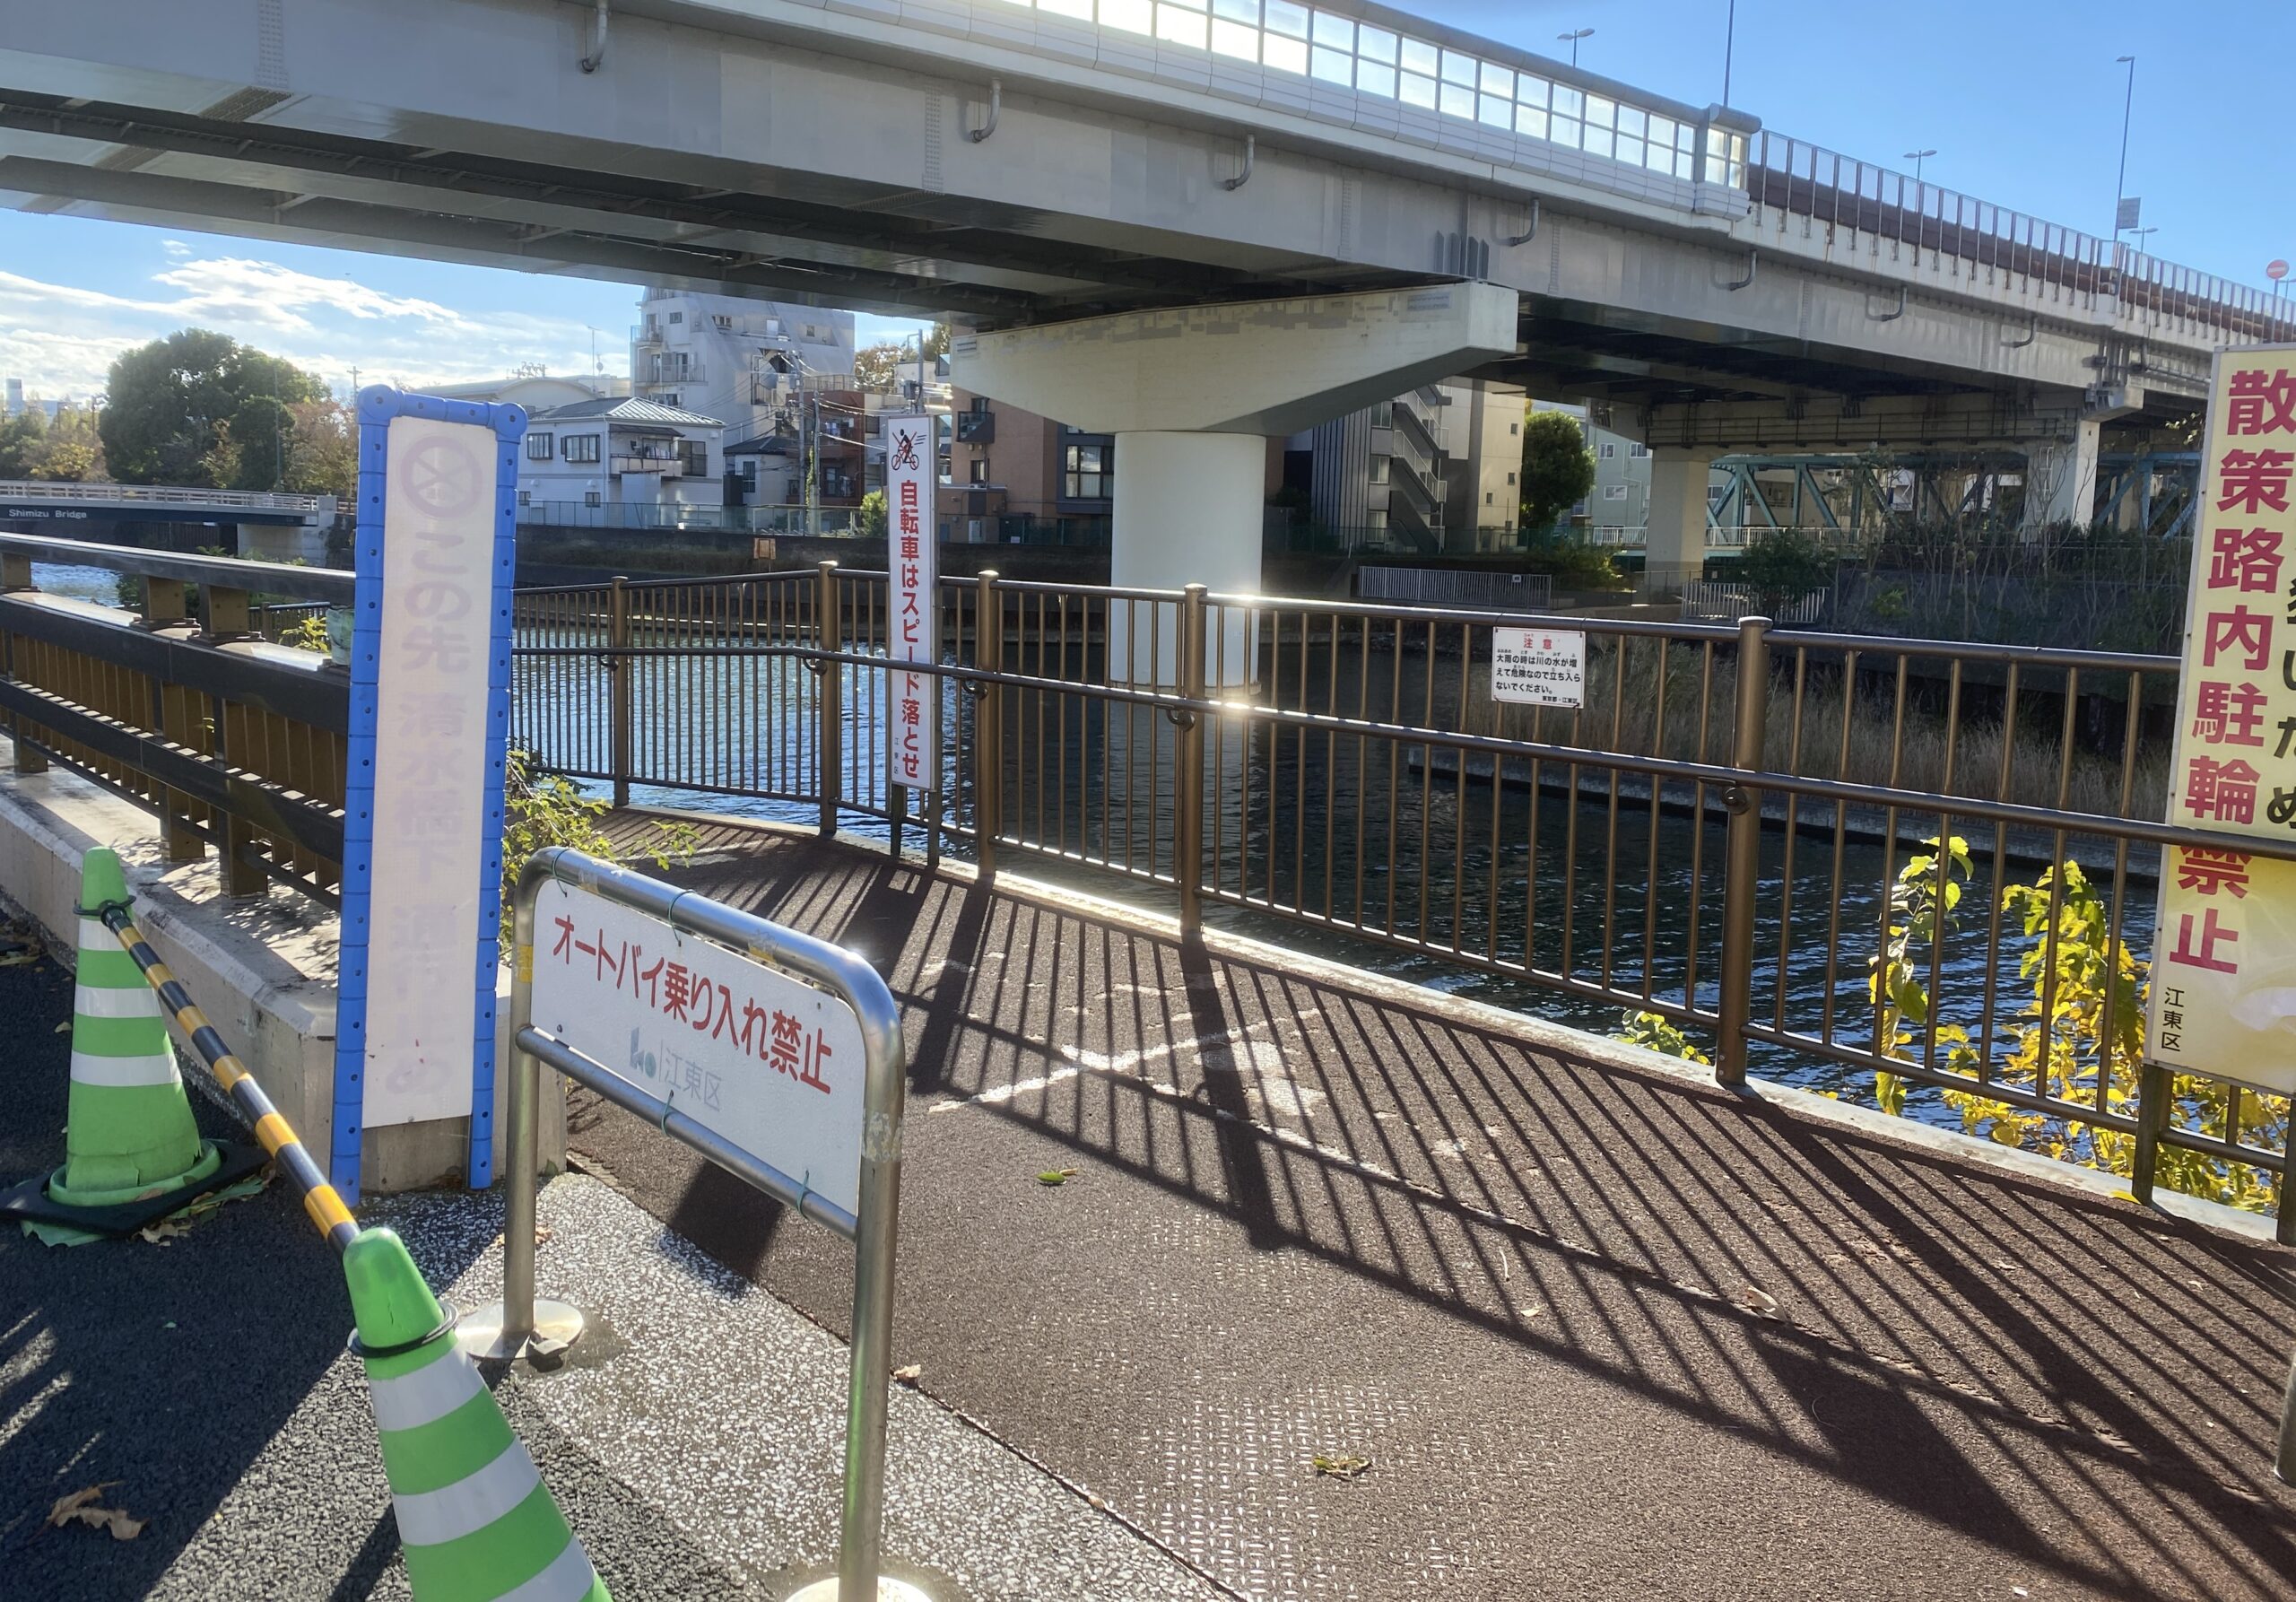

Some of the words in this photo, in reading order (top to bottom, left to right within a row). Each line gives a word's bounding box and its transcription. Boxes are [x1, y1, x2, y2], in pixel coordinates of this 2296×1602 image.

[8, 509, 49, 518] Shimizu
[55, 509, 87, 519] Bridge
[900, 479, 920, 779] 自転車はスピード落とせ
[1496, 654, 1578, 668] 大雨の時は川の水が増
[1495, 682, 1553, 694] ないでください。
[1496, 667, 1581, 683] えて危険なので立ち入ら
[2169, 369, 2296, 975] 散策路内駐輪禁止
[552, 914, 832, 1095] オートバイ乗り入れ禁止
[2160, 986, 2186, 1053] 江東区
[665, 1046, 723, 1113] 江東区
